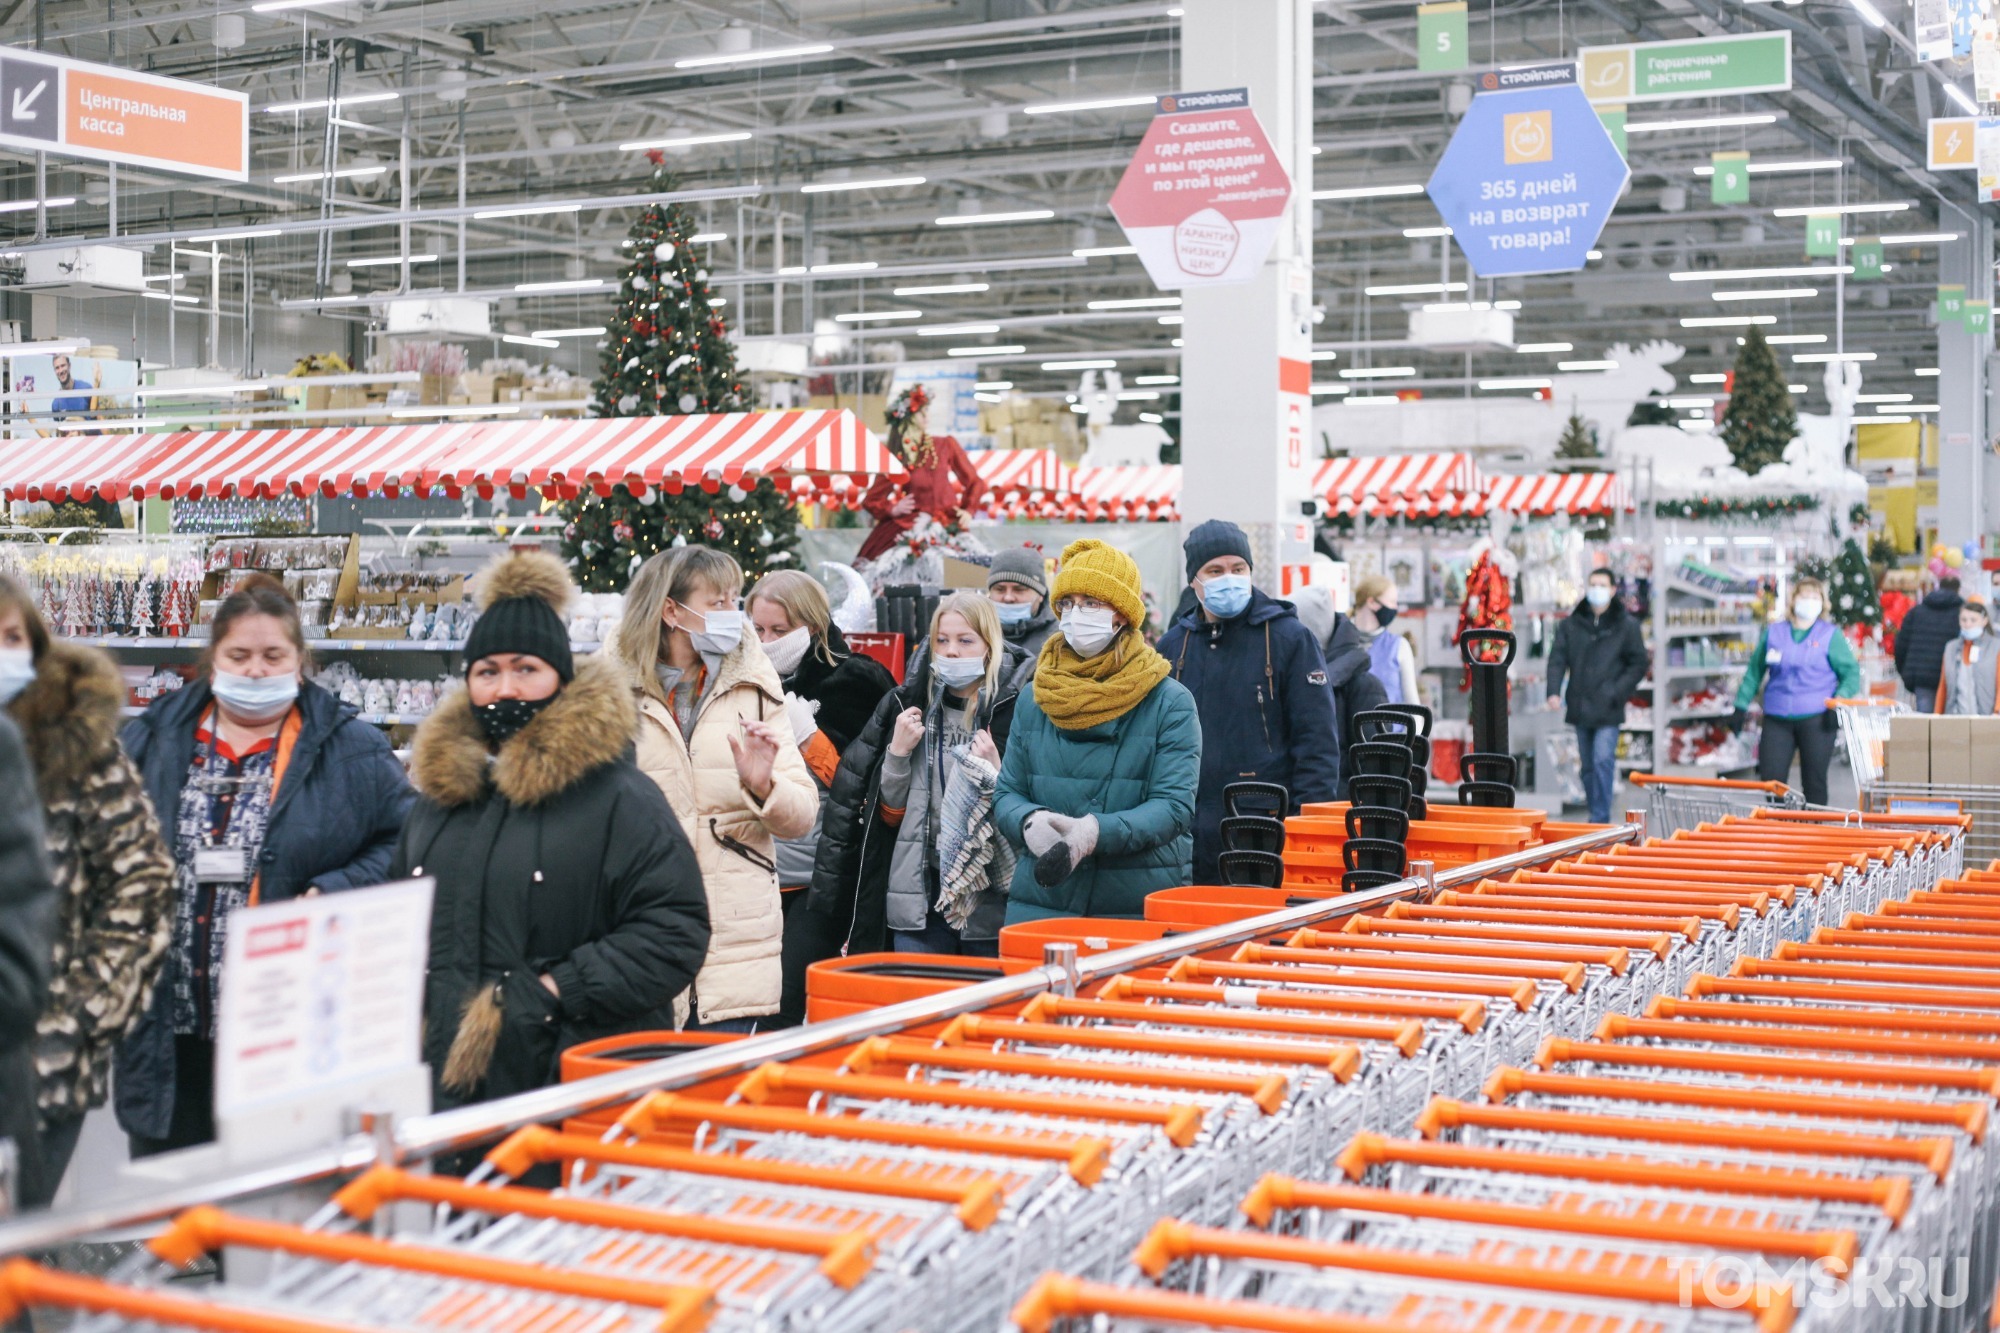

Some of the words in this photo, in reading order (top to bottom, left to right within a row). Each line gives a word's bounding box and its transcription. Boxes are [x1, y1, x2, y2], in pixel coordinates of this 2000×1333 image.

[1437, 31, 1451, 52] 5
[1647, 54, 1728, 72] Горшечные
[1500, 69, 1571, 84] СТРОЙПАРК
[1647, 69, 1712, 88] растения
[80, 88, 186, 123] Центральная
[1177, 92, 1244, 108] СТРОЙПАРК
[79, 115, 125, 136] касса
[1169, 118, 1240, 136] Скажите,
[1154, 143, 1181, 157] где
[1183, 136, 1255, 155] дешевле,
[1145, 163, 1157, 174] и
[1159, 160, 1185, 173] мы
[1188, 153, 1266, 172] продадим
[1153, 180, 1173, 191] по
[1175, 173, 1211, 190] этой
[1480, 179, 1517, 200] 365
[1521, 173, 1577, 201] дней
[1724, 173, 1738, 190] 9
[1469, 210, 1496, 226] на
[1501, 202, 1590, 224] возврат
[1179, 227, 1236, 242] ГАРАНТИЯ
[1488, 226, 1571, 252] товара!
[1815, 229, 1832, 244] 11
[1861, 253, 1877, 268] 13
